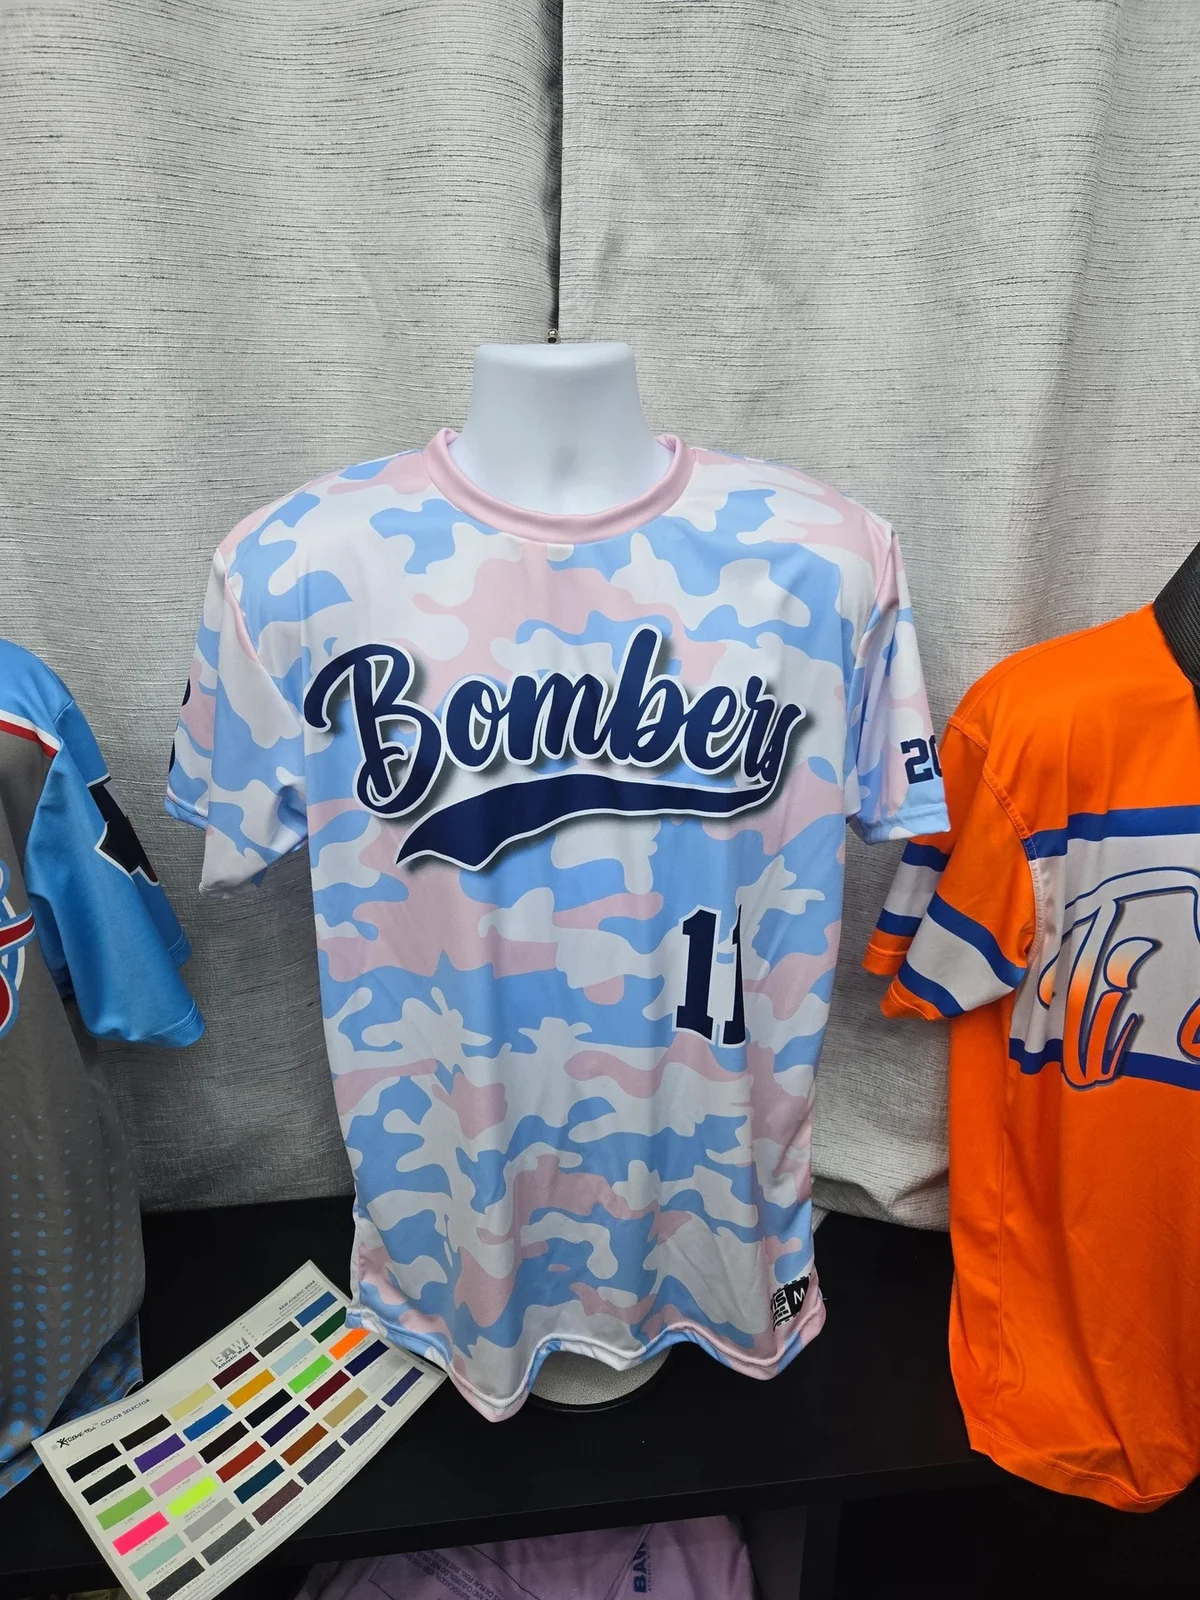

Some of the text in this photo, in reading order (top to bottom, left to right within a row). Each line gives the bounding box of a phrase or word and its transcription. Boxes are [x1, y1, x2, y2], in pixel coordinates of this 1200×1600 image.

[304, 627, 803, 818] Bombers
[100, 1413, 122, 1426] COLOR
[122, 1398, 150, 1415] SELECTOR
